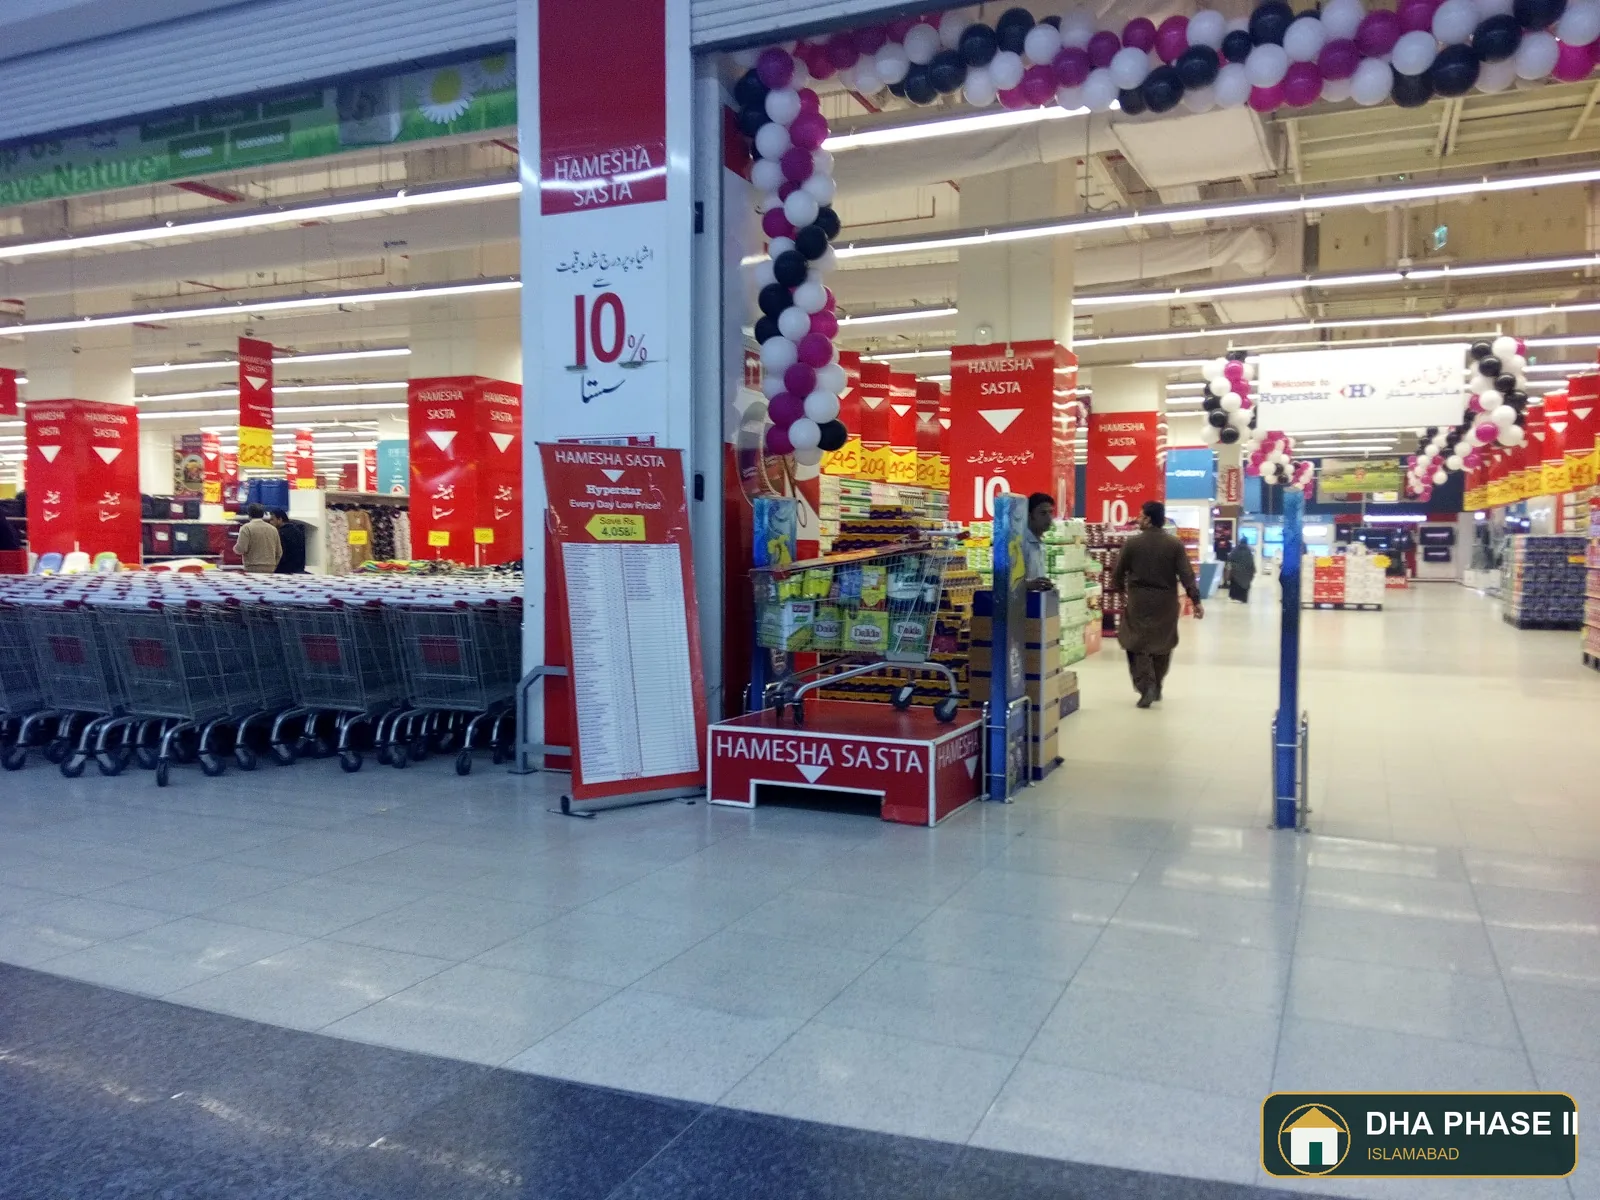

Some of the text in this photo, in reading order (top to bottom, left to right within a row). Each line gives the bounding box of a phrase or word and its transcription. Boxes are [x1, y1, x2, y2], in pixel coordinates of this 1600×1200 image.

[554, 147, 652, 180] HAMESHA
[54, 157, 157, 192] Nature
[573, 181, 632, 207] SASTA
[967, 358, 1035, 374] HAMESHA
[980, 381, 1022, 396] SASTA
[418, 390, 464, 402] HAMESHA
[483, 391, 520, 406] HAMESHA
[1259, 391, 1331, 404] Hyperstar
[83, 412, 128, 425] HAMESHA
[427, 408, 456, 420] SASTA
[490, 410, 513, 423] SASTA
[38, 426, 60, 437] SASTA
[92, 427, 121, 439] SASTA
[1099, 422, 1146, 433] HAMESHA
[1107, 437, 1136, 447] SASTA
[555, 450, 666, 468] HAMESHA SASTA
[860, 456, 886, 477] 209
[1174, 469, 1204, 479] Galaxy
[585, 484, 642, 496] Hyperstar
[569, 499, 661, 511] Every Day Low Price!
[600, 516, 621, 525] Save
[854, 628, 880, 637] Dalda
[716, 736, 923, 774] HAMESHA SASTA
[937, 731, 979, 769] HAMESHA
